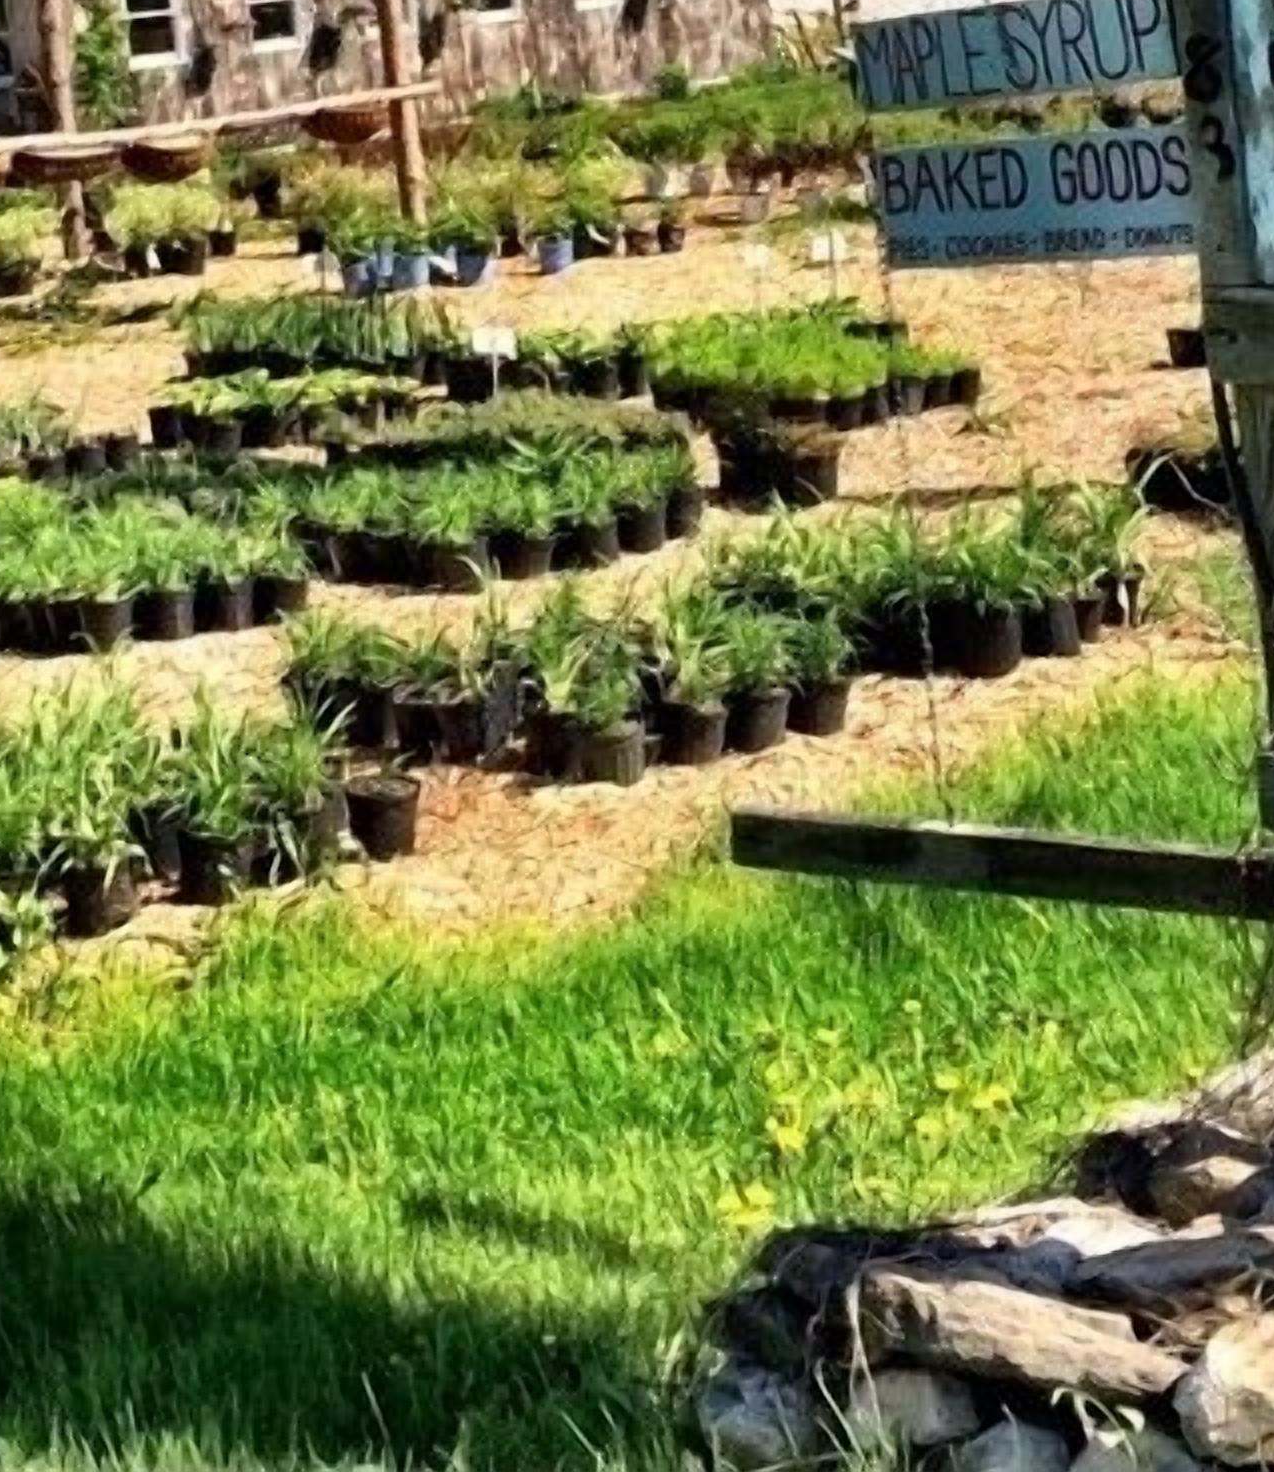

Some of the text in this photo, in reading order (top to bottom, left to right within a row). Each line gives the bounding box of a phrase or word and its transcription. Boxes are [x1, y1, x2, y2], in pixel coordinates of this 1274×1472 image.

[855, 8, 1002, 108] MAPLE
[880, 134, 1192, 216] BAKED GOODS
